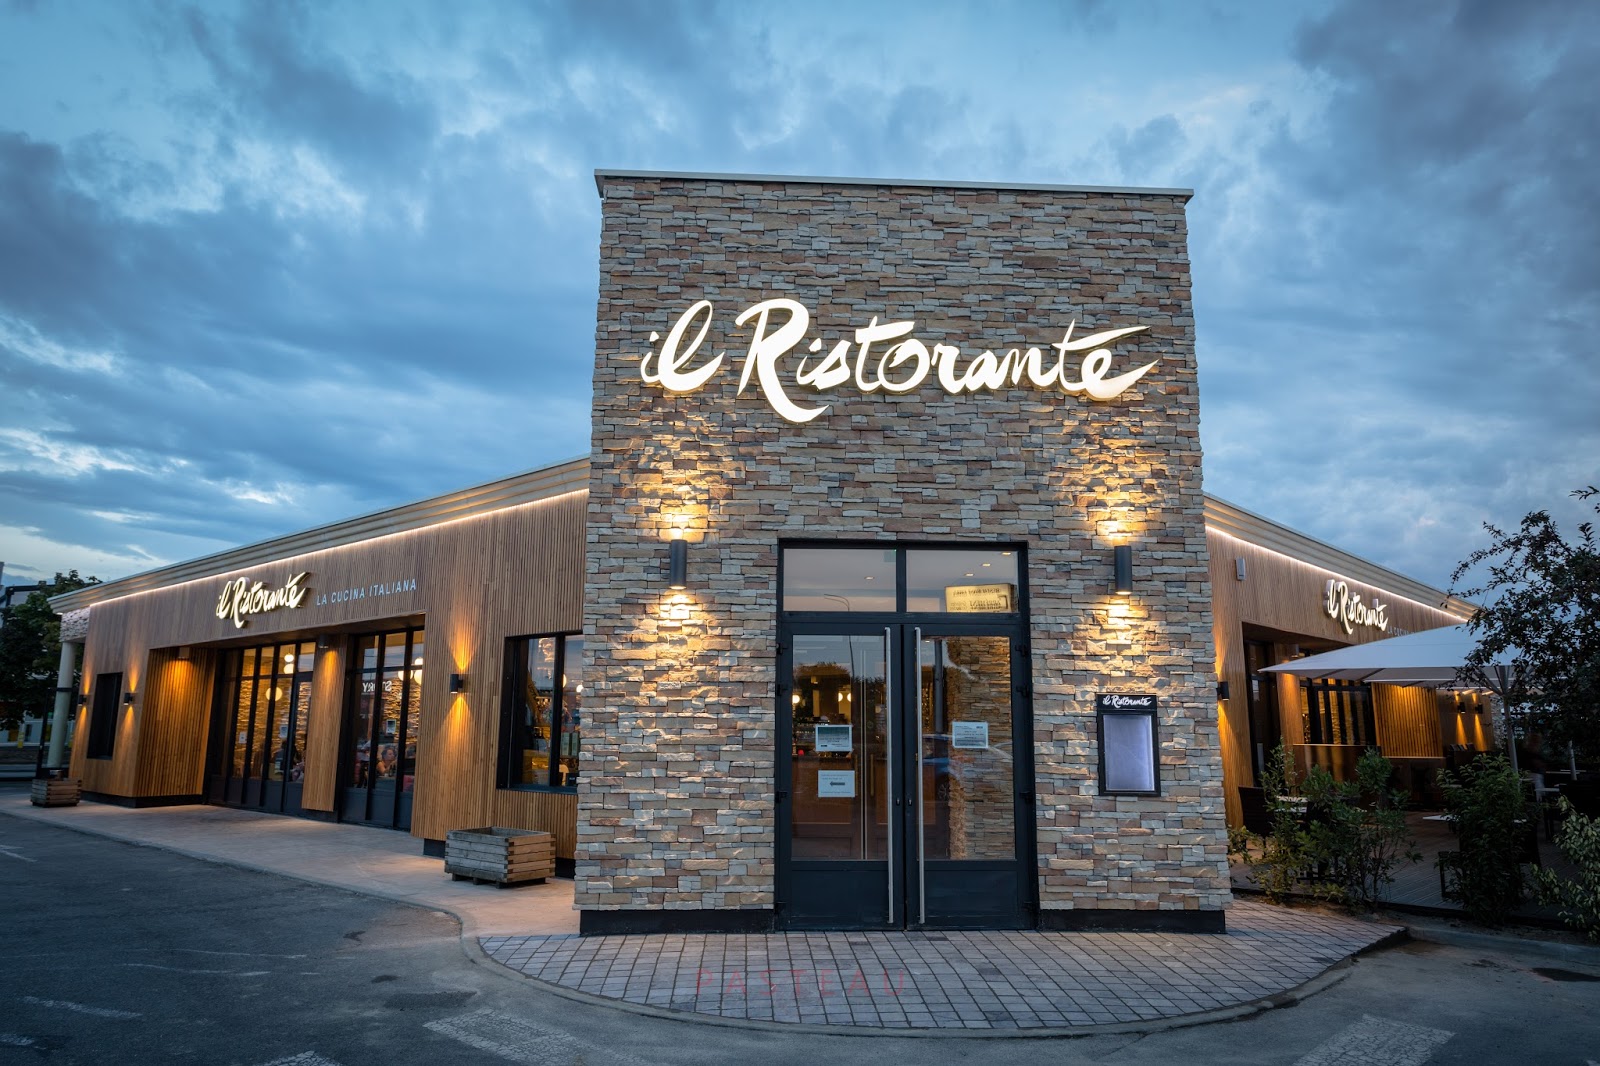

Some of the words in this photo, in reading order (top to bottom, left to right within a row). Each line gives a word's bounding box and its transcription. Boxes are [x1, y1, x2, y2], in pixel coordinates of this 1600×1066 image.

[640, 299, 726, 393] il
[735, 298, 1160, 423] Ristorante
[215, 579, 233, 620] il
[231, 571, 309, 629] Ristorante
[316, 593, 328, 606] LA
[331, 587, 366, 604] CUCINA
[369, 578, 417, 598] ITALIANA
[1326, 579, 1339, 619] il
[1338, 581, 1389, 635] Ristorante
[1111, 695, 1152, 709] Ristorante
